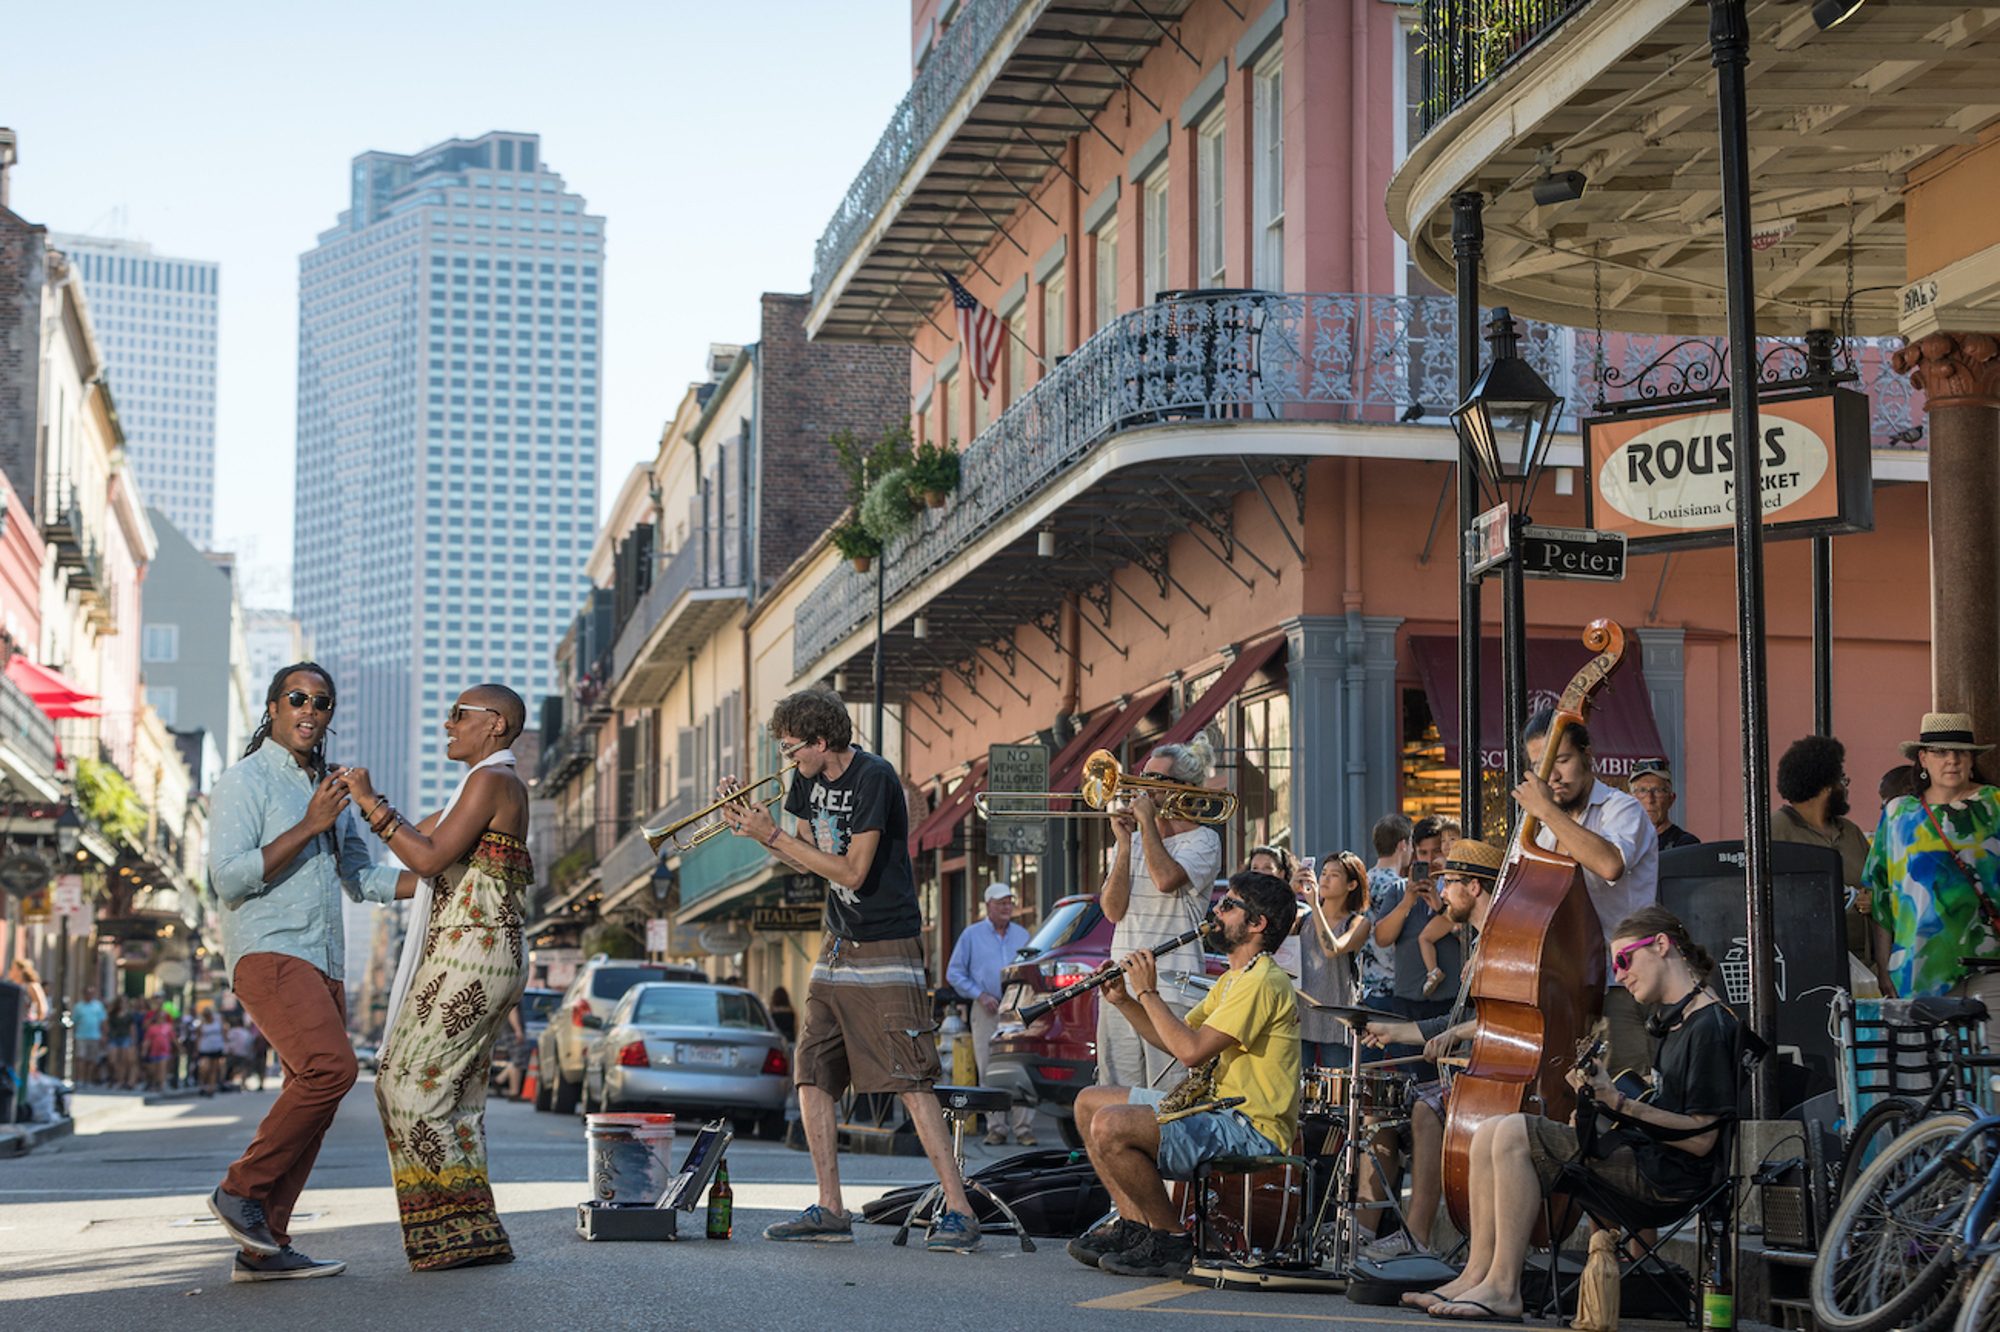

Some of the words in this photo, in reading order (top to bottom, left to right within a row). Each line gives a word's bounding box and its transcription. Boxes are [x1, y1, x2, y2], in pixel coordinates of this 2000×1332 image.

[1627, 427, 1786, 486] ROUSS
[1725, 472, 1801, 495] MRKET
[1648, 504, 1721, 521] Louisiana
[1726, 493, 1782, 513] Oed
[1543, 543, 1619, 572] Peter
[1008, 750, 1030, 761] NO
[993, 763, 1044, 773] VEHICLES
[993, 774, 1043, 785] ALLOWED
[756, 908, 798, 923] ITALY
